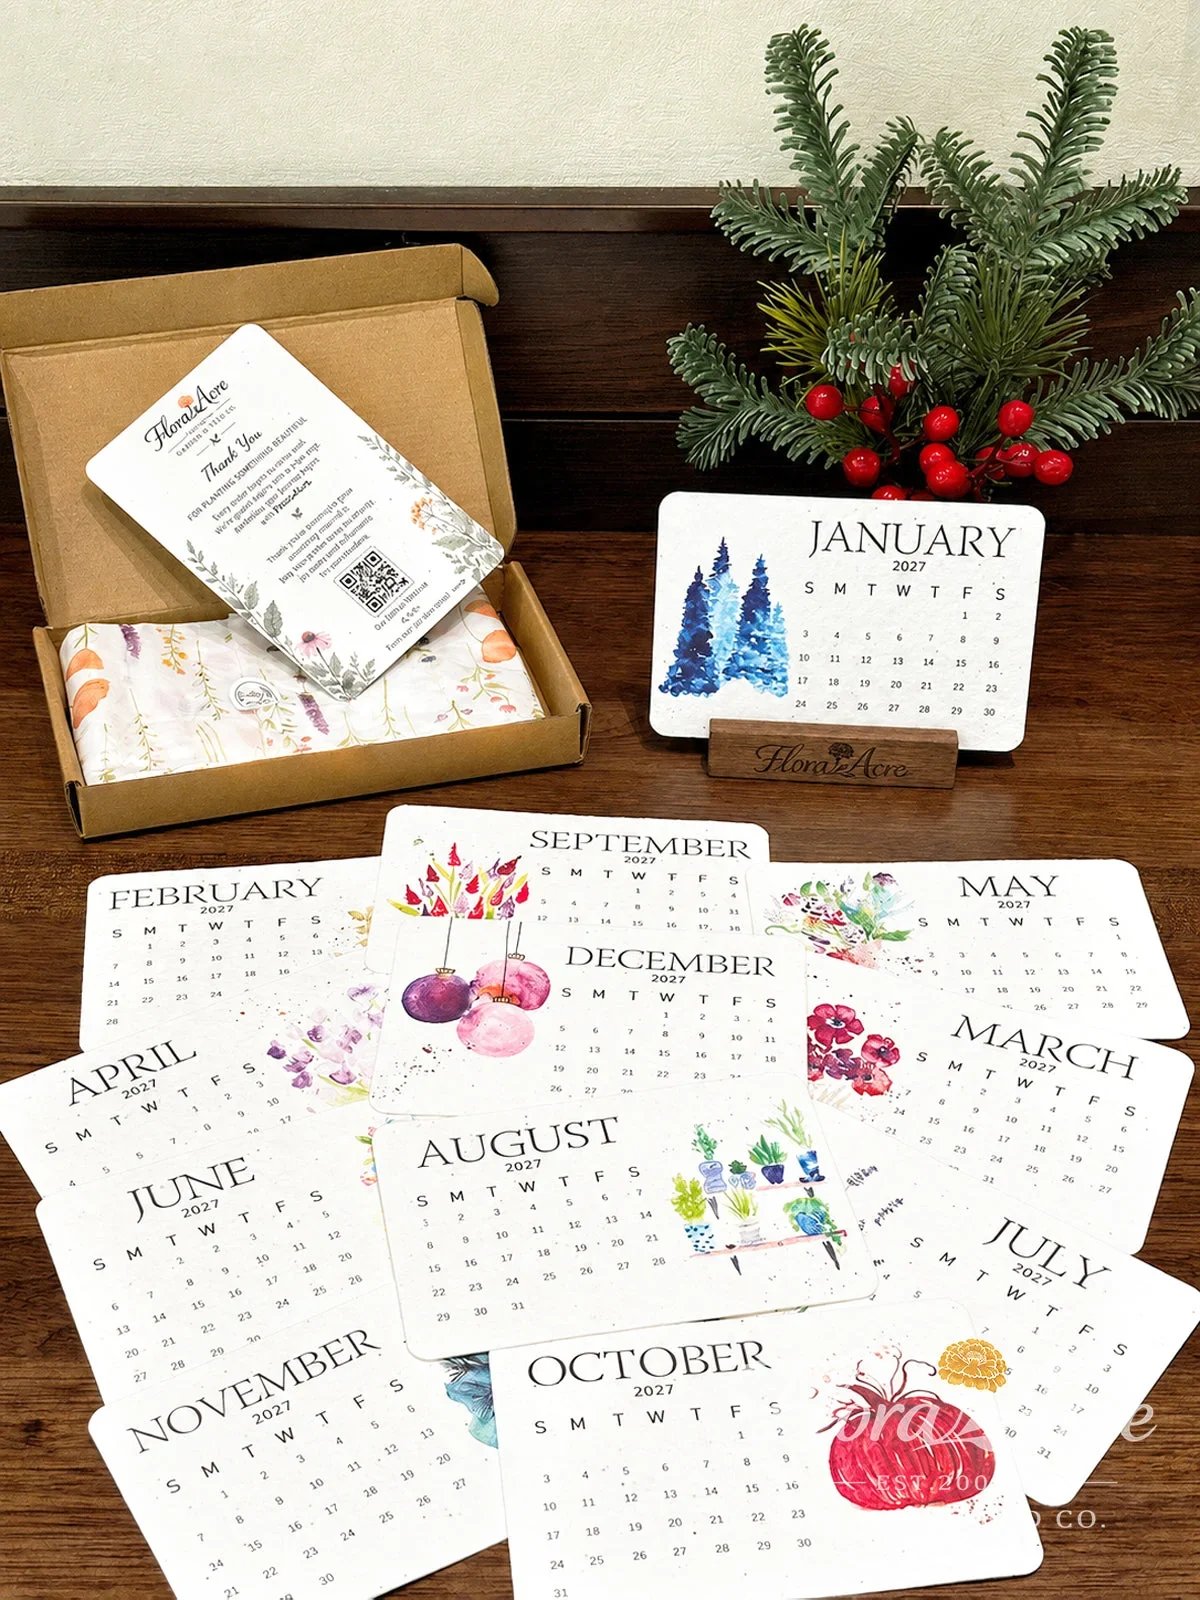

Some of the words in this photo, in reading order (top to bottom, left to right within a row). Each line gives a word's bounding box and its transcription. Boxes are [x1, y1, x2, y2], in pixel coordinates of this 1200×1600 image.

[195, 379, 229, 413] Acre
[200, 446, 238, 482] Thank
[235, 432, 263, 452] You
[809, 519, 1017, 559] JANUARY
[891, 559, 927, 573] 2027
[804, 580, 815, 595] S
[833, 581, 847, 596] M
[867, 582, 878, 597] T
[896, 583, 912, 598] W
[930, 585, 941, 599] T
[962, 586, 974, 600] F
[995, 587, 1006, 601] S
[799, 653, 811, 662] 10
[830, 654, 841, 663] 11
[860, 655, 872, 665] 12
[892, 656, 904, 666] 13
[923, 657, 934, 667] 14
[955, 658, 967, 668] 15
[988, 660, 1000, 669] 16
[797, 676, 809, 685] 17
[828, 677, 840, 687] 18
[859, 679, 871, 688] 19
[890, 680, 903, 689] 20
[920, 681, 932, 691] 21
[952, 682, 965, 692] 22
[985, 683, 998, 694] 23
[754, 743, 829, 774] Flora
[849, 746, 909, 779] Acre
[529, 830, 752, 860] SEPTEMBER
[623, 855, 657, 865] 2027
[109, 877, 323, 911] FEBRUARY
[957, 875, 1059, 898] MAY
[200, 904, 234, 915] 2027
[997, 900, 1031, 910] 2027
[112, 928, 123, 939] S
[143, 925, 157, 936] M
[177, 923, 188, 933] T
[208, 921, 224, 931] W
[243, 919, 254, 929] T
[277, 917, 287, 928] F
[310, 915, 321, 925] S
[565, 945, 776, 978] DECEMBER
[651, 973, 687, 984] 2027
[561, 987, 572, 998] S
[592, 988, 606, 1000] M
[628, 989, 640, 1001] T
[659, 992, 676, 1003] W
[698, 993, 709, 1005] T
[732, 996, 743, 1007] F
[765, 998, 777, 1009] S
[555, 1044, 567, 1052] 12
[589, 1046, 601, 1054] 13
[624, 1047, 636, 1055] 14
[658, 1049, 671, 1058] 15
[695, 1051, 708, 1059] 16
[731, 1053, 742, 1061] 17
[765, 1055, 777, 1063] 18
[950, 1015, 1139, 1081] MARCH
[68, 1040, 198, 1107] APRIL
[1018, 1057, 1057, 1074] 2027
[121, 1078, 156, 1100] 2027
[915, 1051, 928, 1063] S
[947, 1059, 964, 1073] M
[985, 1068, 997, 1080] T
[1017, 1076, 1034, 1089] W
[1055, 1085, 1066, 1097] T
[1088, 1095, 1101, 1106] F
[1124, 1105, 1137, 1117] S
[44, 1141, 59, 1155] S
[75, 1127, 93, 1142] M
[109, 1114, 122, 1126] T
[140, 1100, 158, 1114] W
[177, 1086, 189, 1098] T
[210, 1074, 221, 1087] F
[242, 1062, 256, 1075] S
[418, 1117, 619, 1169] AUGUST
[504, 1158, 542, 1173] 2027
[127, 1157, 256, 1224] JUNE
[416, 1194, 429, 1208] S
[449, 1190, 465, 1203] M
[485, 1185, 497, 1198] T
[517, 1180, 536, 1193] W
[558, 1175, 569, 1188] T
[594, 1170, 605, 1183] F
[628, 1166, 641, 1178] S
[180, 1198, 219, 1219] 2027
[428, 1263, 441, 1273] 15
[464, 1258, 478, 1268] 16
[500, 1253, 513, 1263] 17
[537, 1248, 551, 1258] 18
[574, 1243, 588, 1253] 19
[610, 1238, 625, 1248] 20
[645, 1233, 659, 1243] 21
[982, 1216, 1113, 1290] JULY
[1011, 1262, 1053, 1287] 2027
[116, 1324, 131, 1336] 13
[152, 1312, 167, 1324] 14
[191, 1300, 206, 1311] 15
[228, 1287, 243, 1299] 16
[265, 1275, 278, 1287] 17
[302, 1263, 318, 1274] 18
[909, 1236, 925, 1249] S
[938, 1251, 957, 1267] M
[976, 1268, 990, 1282] T
[1006, 1284, 1027, 1301] W
[1045, 1304, 1059, 1317] T
[1078, 1323, 1095, 1335] F
[1112, 1343, 1128, 1357] S
[527, 1340, 772, 1388] OCTOBER
[126, 1329, 382, 1454] NOVEMBER
[633, 1383, 674, 1398] 2027
[251, 1399, 291, 1426] 2027
[166, 1478, 181, 1494] S
[200, 1461, 220, 1479] M
[241, 1443, 255, 1459] T
[273, 1426, 295, 1444] W
[314, 1410, 329, 1427] T
[352, 1393, 365, 1410] F
[389, 1378, 404, 1393] S
[196, 1532, 204, 1542] 7
[235, 1515, 245, 1525] 8
[309, 1478, 325, 1490] 10
[347, 1461, 362, 1473] 11
[383, 1443, 399, 1456] 12
[420, 1428, 435, 1440] 13
[543, 1501, 557, 1512] 10
[582, 1497, 595, 1508] 11
[624, 1492, 638, 1503] 12
[663, 1489, 678, 1499] 13
[704, 1486, 719, 1496] 14
[745, 1483, 760, 1494] 15
[785, 1480, 800, 1491] 16
